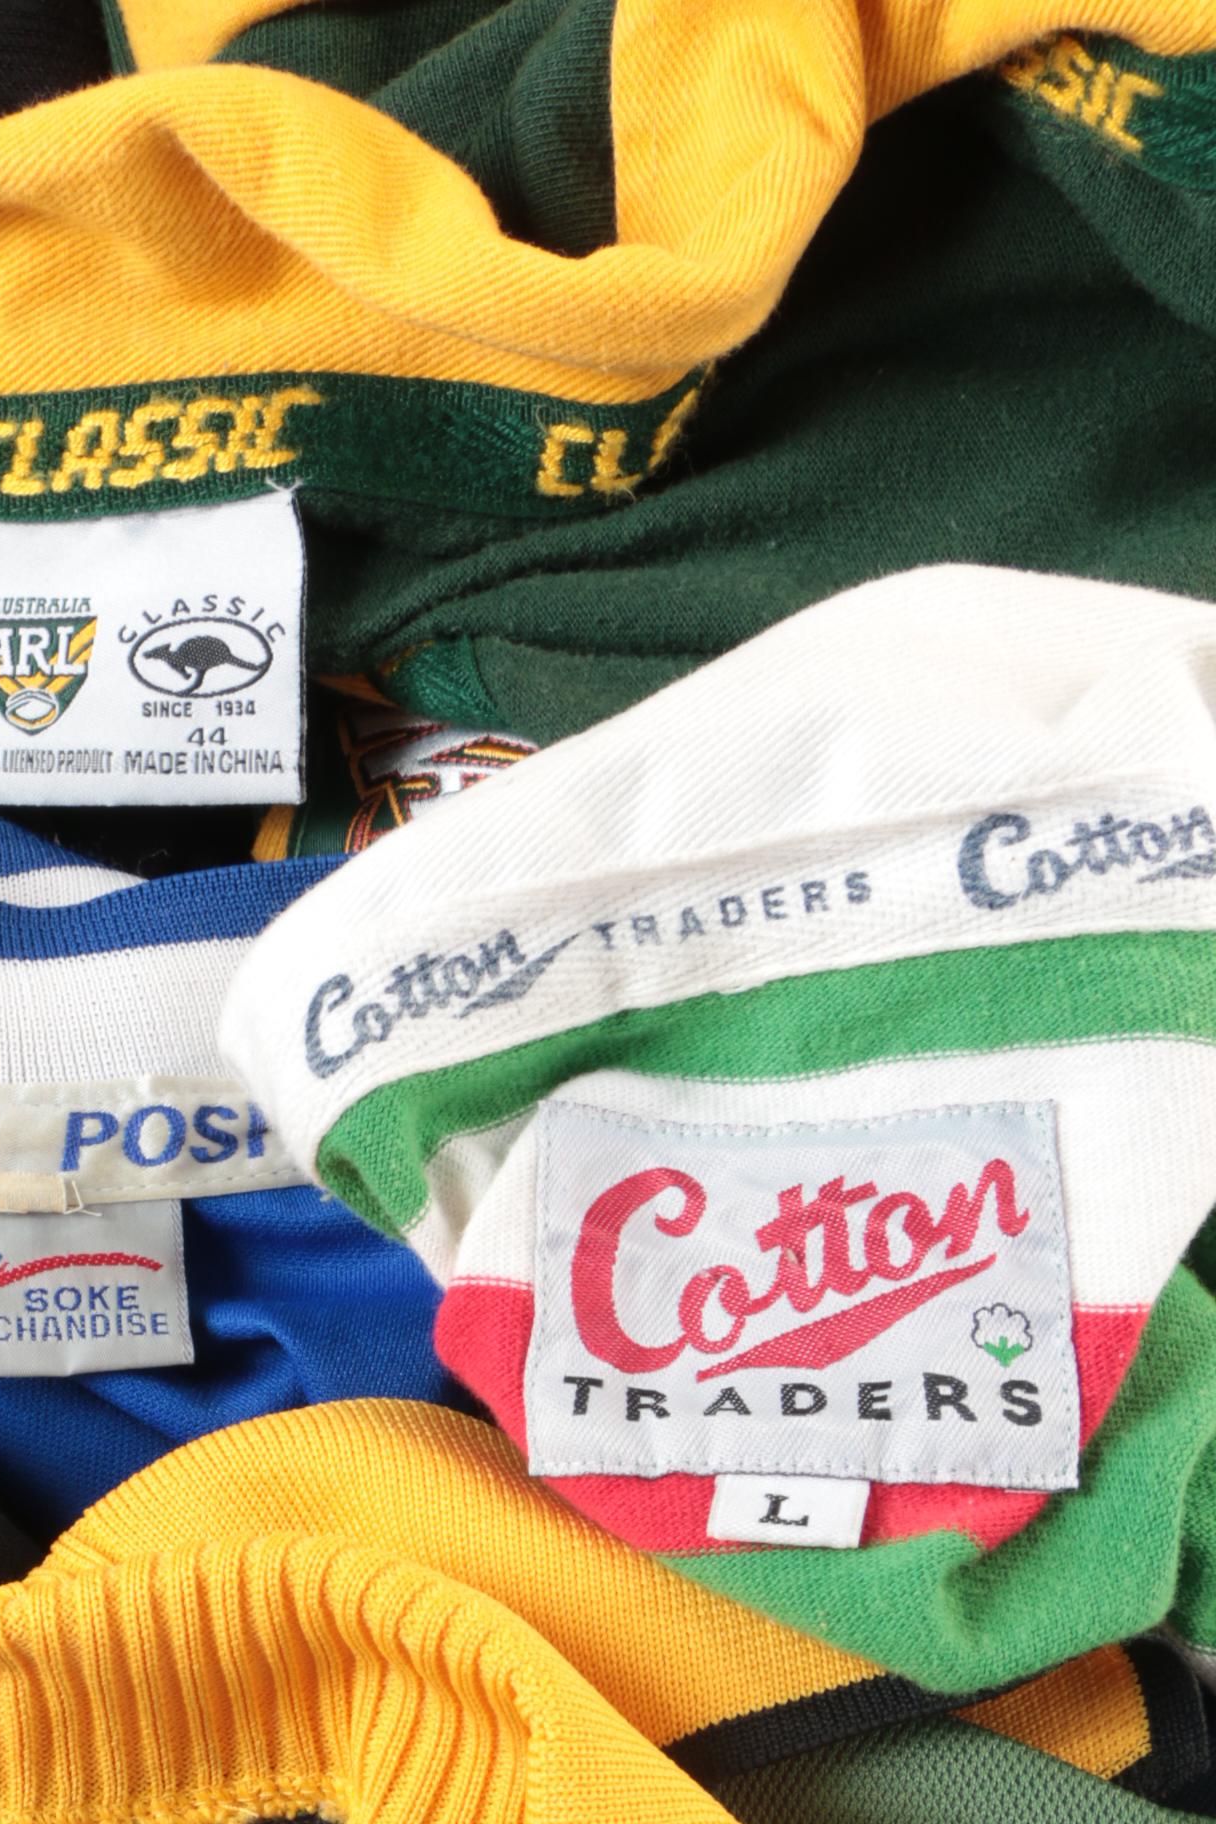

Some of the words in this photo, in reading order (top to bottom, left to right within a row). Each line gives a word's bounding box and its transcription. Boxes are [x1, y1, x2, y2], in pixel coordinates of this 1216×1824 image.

[118, 595, 285, 644] CLASSIC
[142, 701, 192, 717] SINCE
[216, 700, 255, 717] 1934
[186, 727, 228, 746] 44
[1, 747, 54, 773] LICENSED
[56, 747, 113, 774] PRODUCT
[124, 750, 187, 775] MADE
[194, 750, 219, 774] IN
[219, 750, 284, 774] CHINA
[305, 929, 527, 1079] Cotton
[595, 870, 874, 950] TRADERS
[570, 1159, 1029, 1376] Cotton
[24, 1286, 139, 1313] SOKE
[563, 1373, 1043, 1427] TRADERS
[758, 1492, 809, 1527] L
